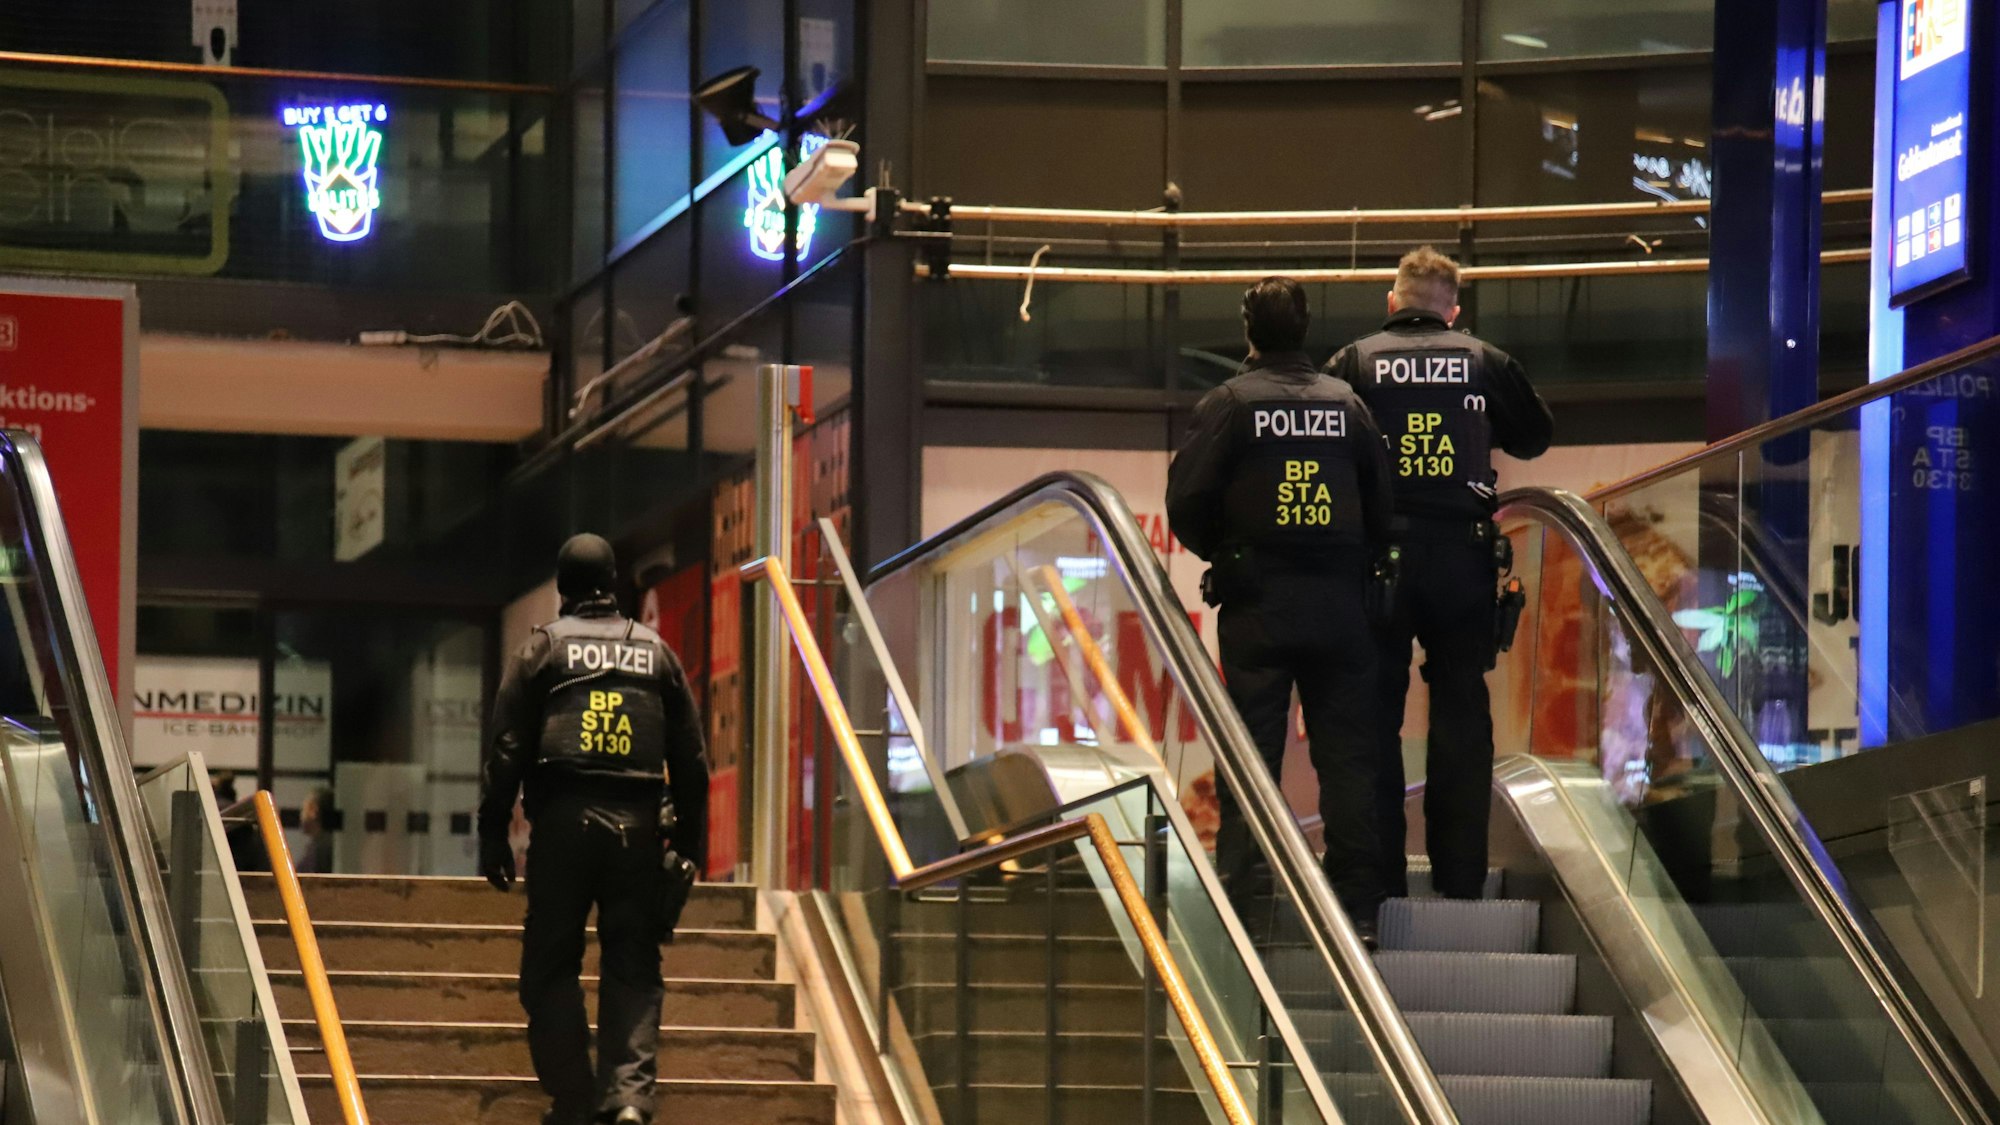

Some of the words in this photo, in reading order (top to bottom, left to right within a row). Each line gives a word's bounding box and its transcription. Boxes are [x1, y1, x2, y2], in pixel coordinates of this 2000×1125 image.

[284, 107, 321, 125] BUY
[338, 105, 373, 122] GET
[1375, 357, 1469, 384] POLIZEI
[1254, 408, 1346, 438] POLIZEI
[1407, 412, 1443, 434] BP
[1400, 434, 1456, 455] STA
[1285, 460, 1320, 481] BP
[1399, 456, 1454, 477] 3130
[1277, 482, 1332, 504] STA
[1276, 504, 1331, 526] 3130
[567, 643, 654, 675] POLIZEI
[589, 690, 624, 712] BP
[581, 710, 633, 735] STA
[580, 731, 632, 755] 3130
